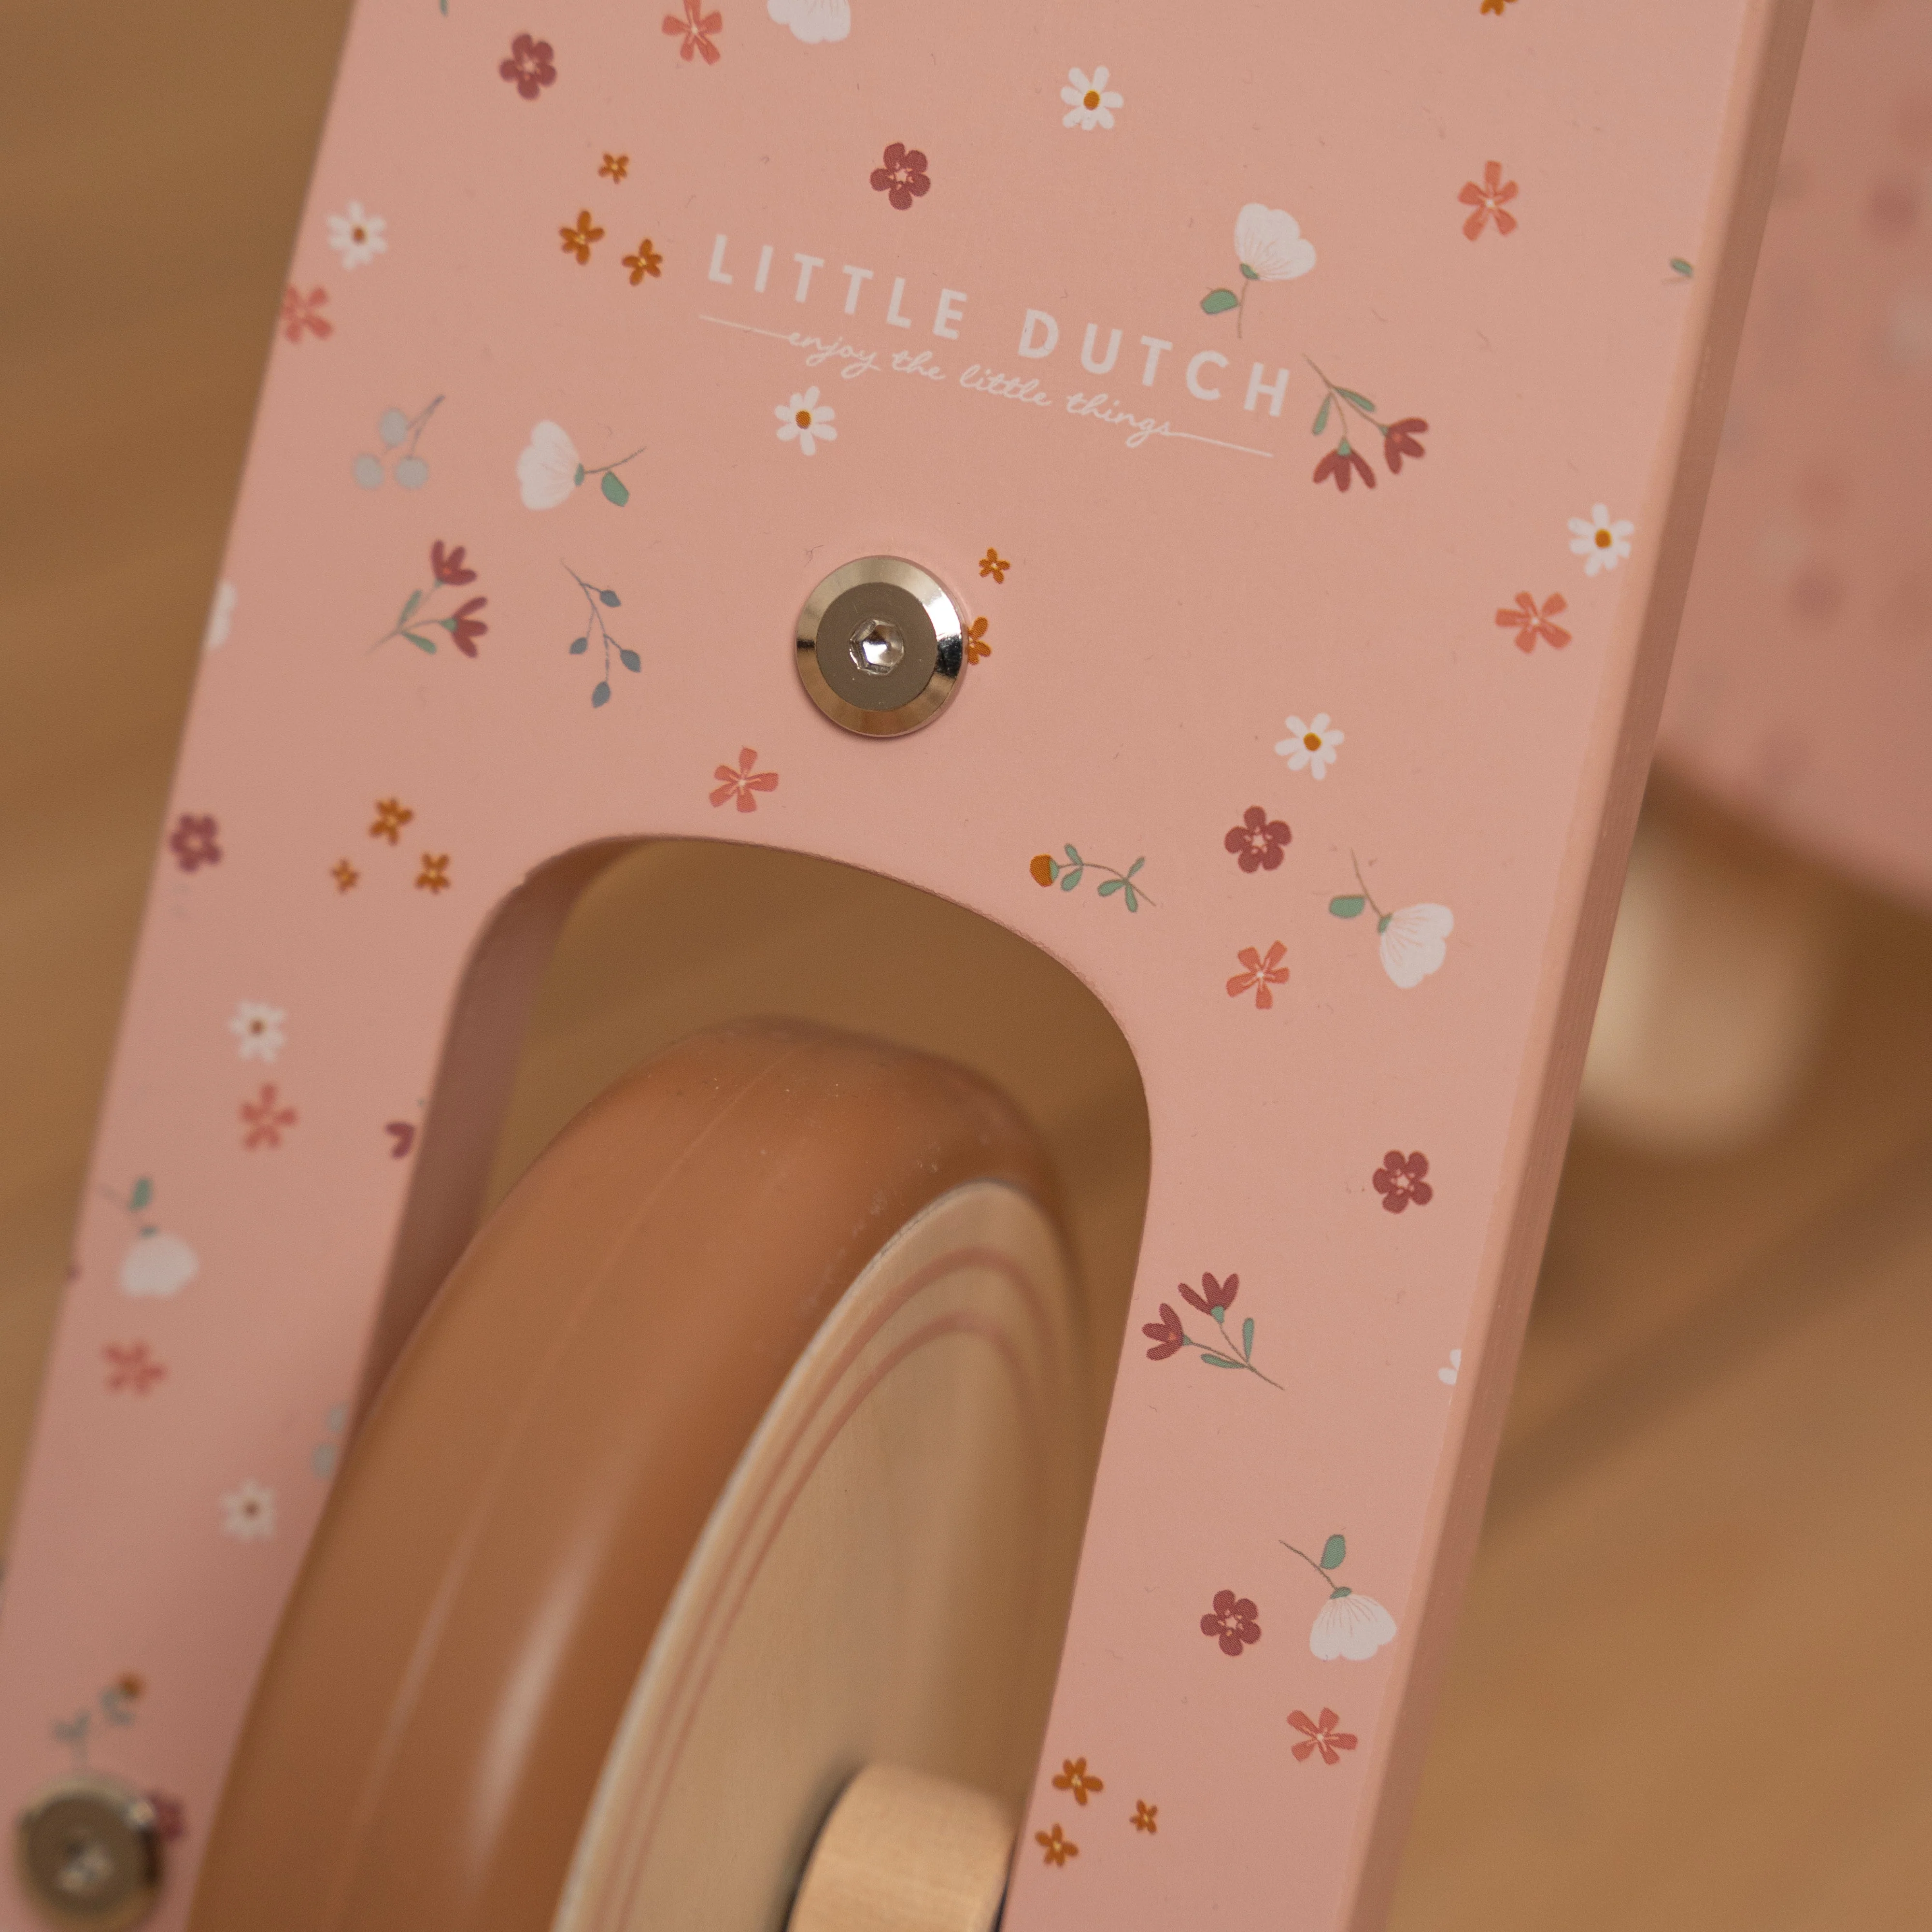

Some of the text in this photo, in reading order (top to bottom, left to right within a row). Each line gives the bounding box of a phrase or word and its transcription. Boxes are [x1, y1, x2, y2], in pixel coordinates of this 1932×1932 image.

[708, 233, 1290, 417] LITTLE DUTCH
[787, 332, 1174, 448] enjoy the little things
